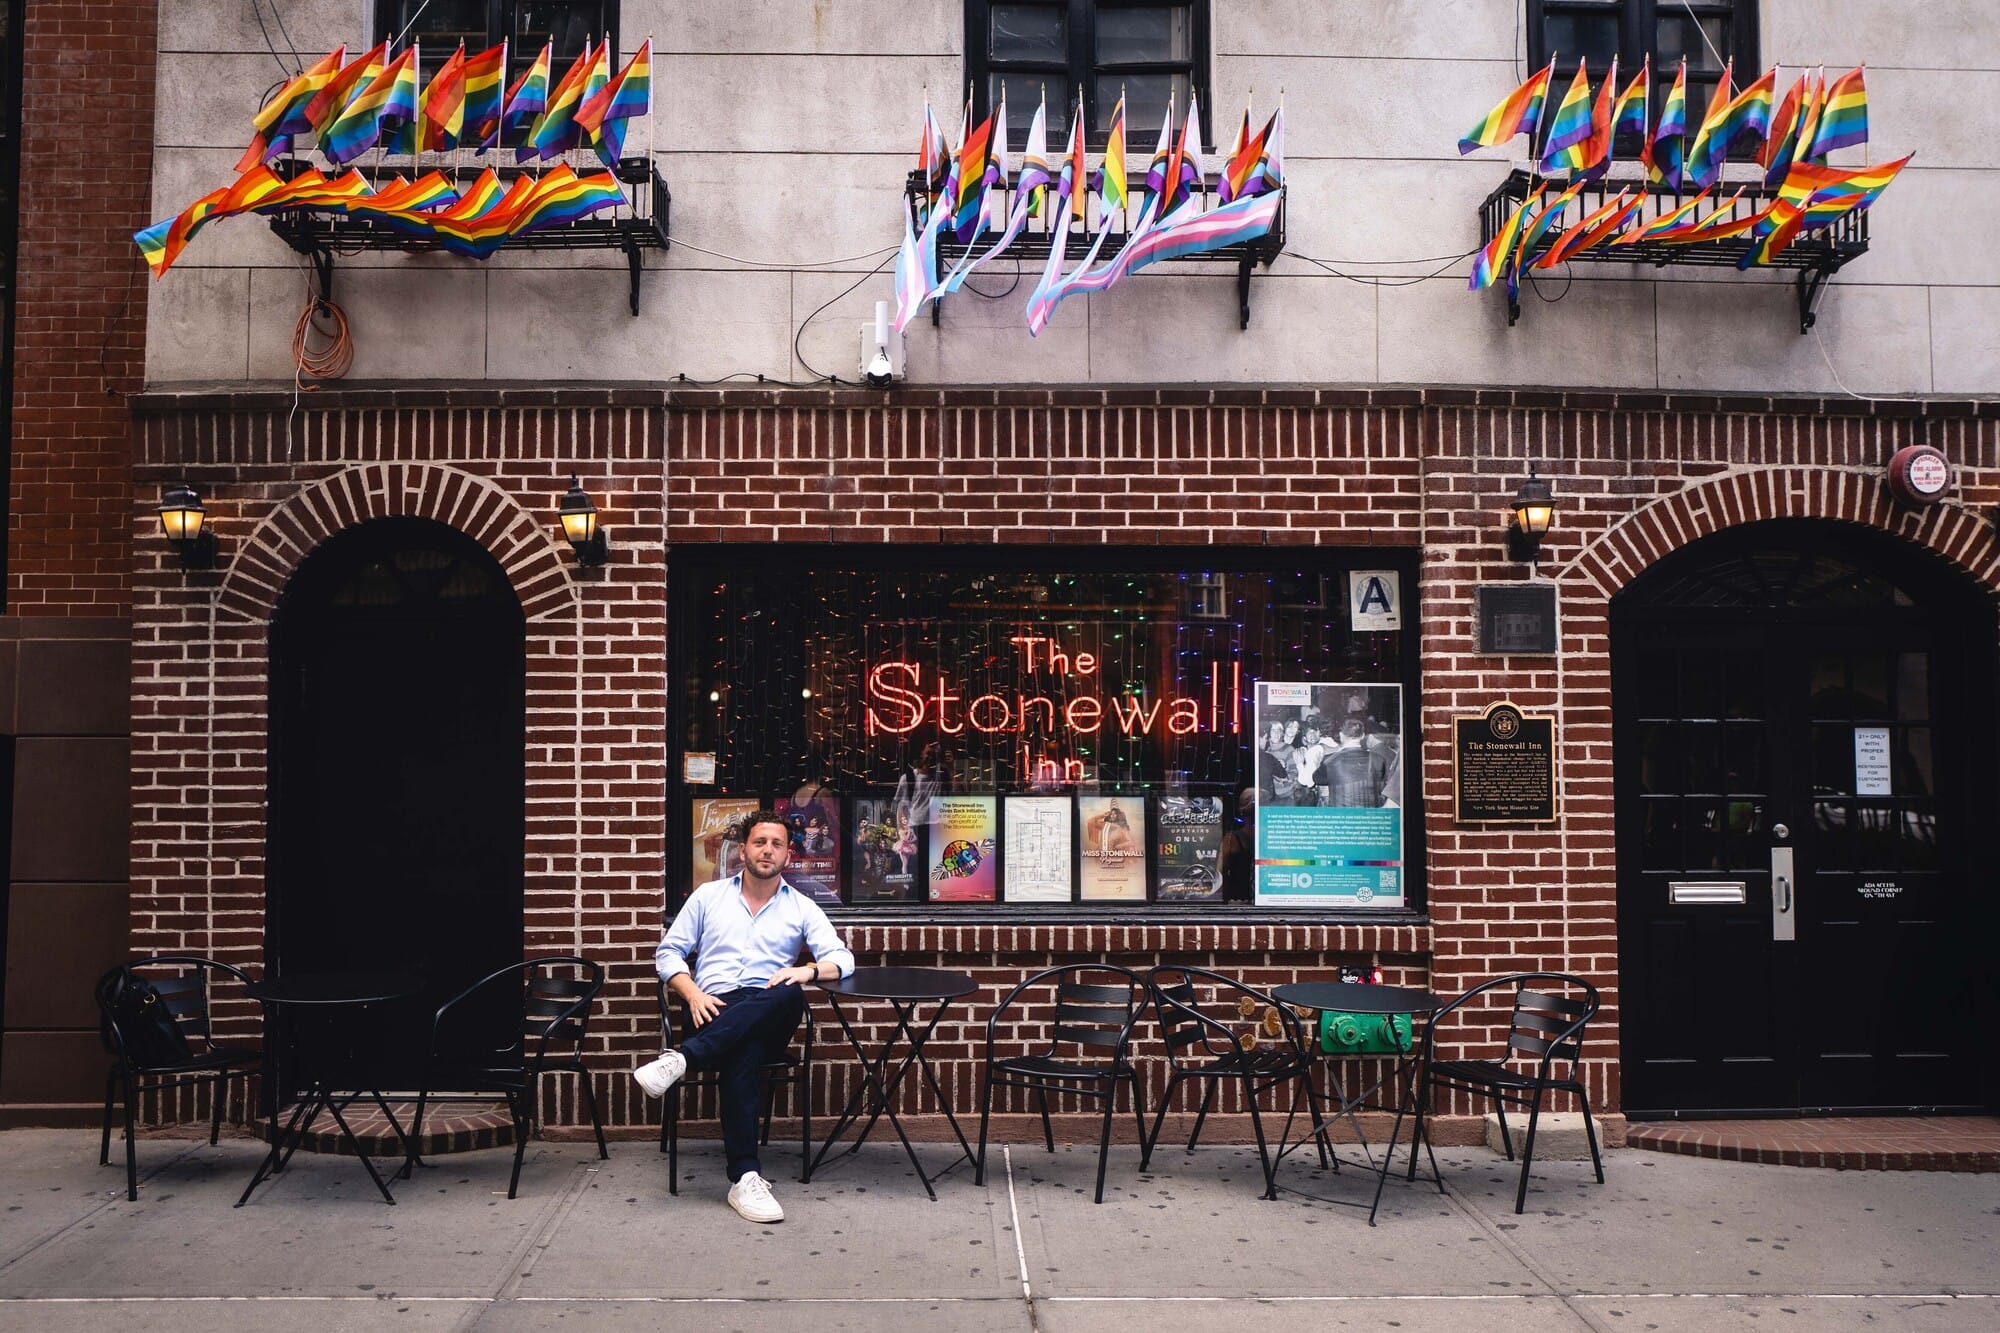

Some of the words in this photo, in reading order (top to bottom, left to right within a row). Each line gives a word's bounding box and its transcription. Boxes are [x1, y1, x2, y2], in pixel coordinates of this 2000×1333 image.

[1359, 576, 1393, 614] A
[1010, 636, 1097, 675] The
[868, 660, 1240, 736] Stonewall
[1023, 743, 1085, 783] Inn
[1468, 742, 1484, 750] The
[1486, 742, 1525, 750] Stonewall
[1528, 742, 1542, 750] Inn
